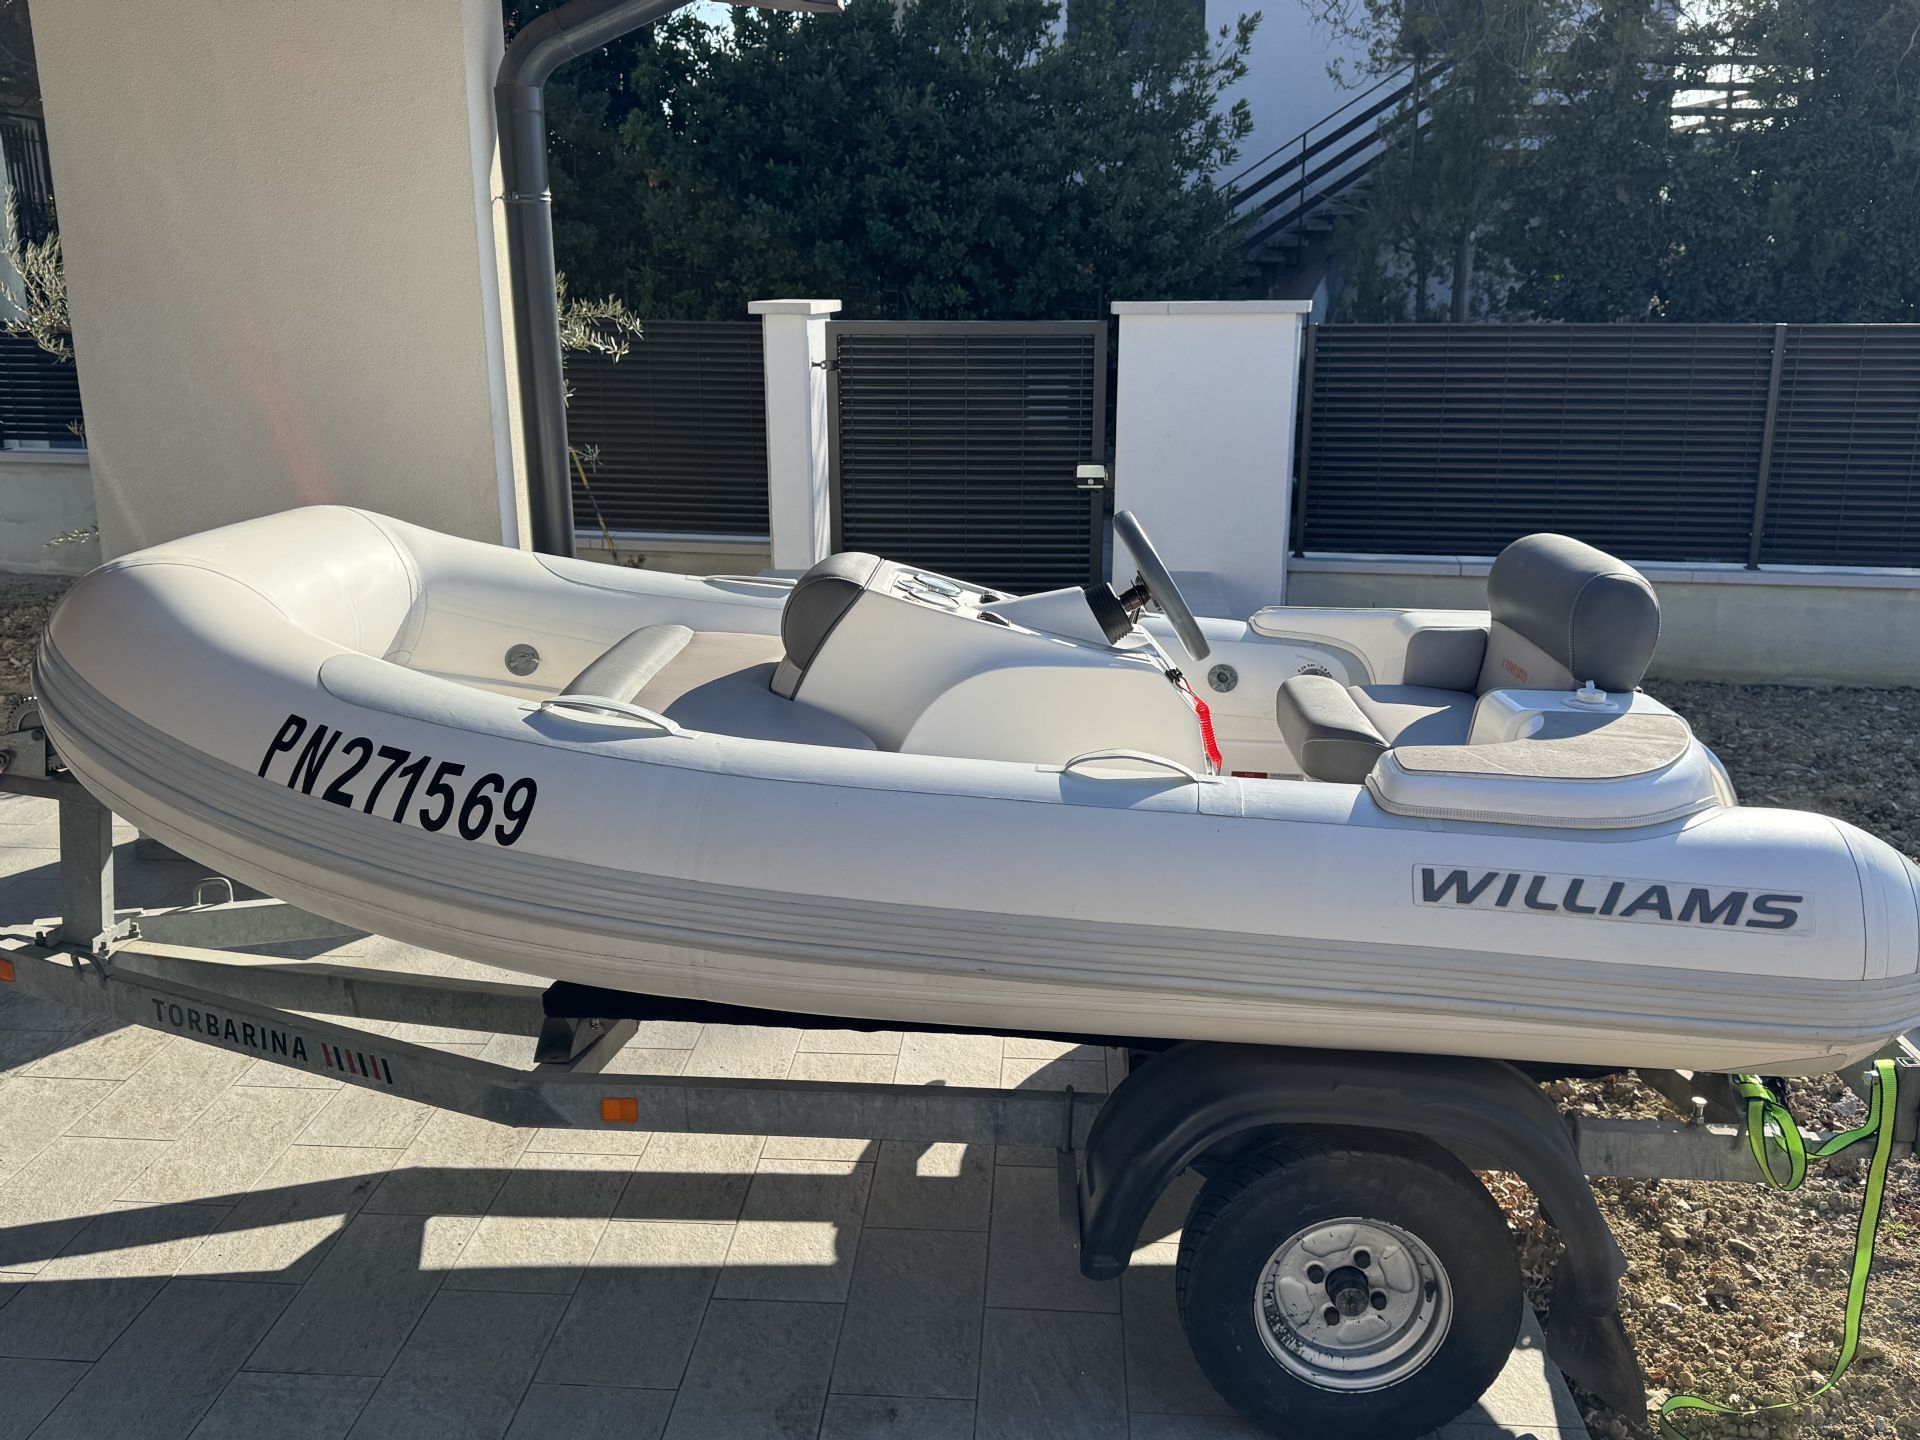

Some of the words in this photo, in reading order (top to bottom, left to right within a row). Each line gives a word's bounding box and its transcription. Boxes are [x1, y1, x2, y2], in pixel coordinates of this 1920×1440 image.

[258, 713, 538, 846] PN271569
[1421, 868, 1804, 930] WILLIAMS
[152, 998, 309, 1062] TORBARINA
